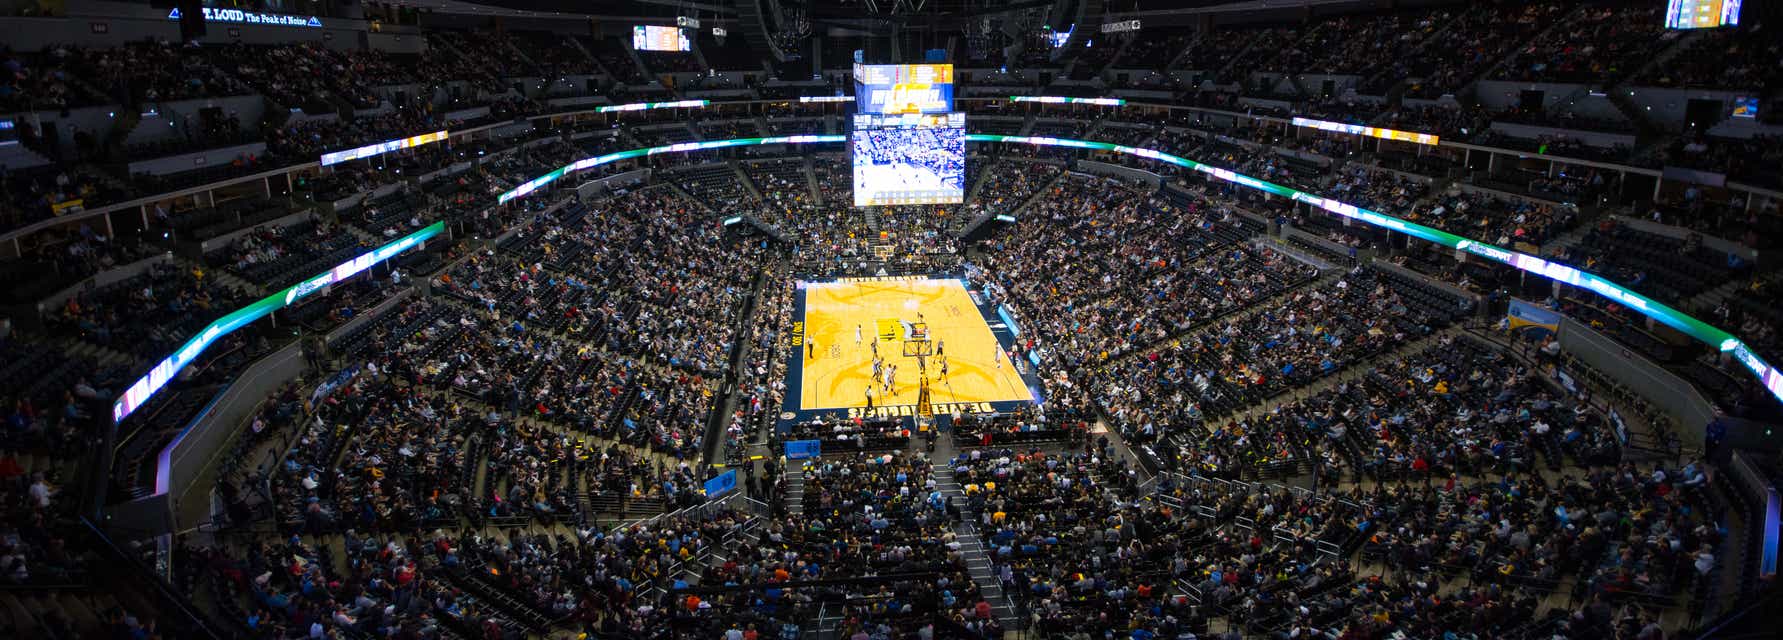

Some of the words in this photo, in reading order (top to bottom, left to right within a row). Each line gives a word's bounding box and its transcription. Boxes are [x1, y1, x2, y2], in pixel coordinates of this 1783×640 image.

[214, 9, 244, 21] LOUD
[245, 13, 260, 22] The
[261, 15, 279, 24] Peak
[288, 17, 307, 26] Noise
